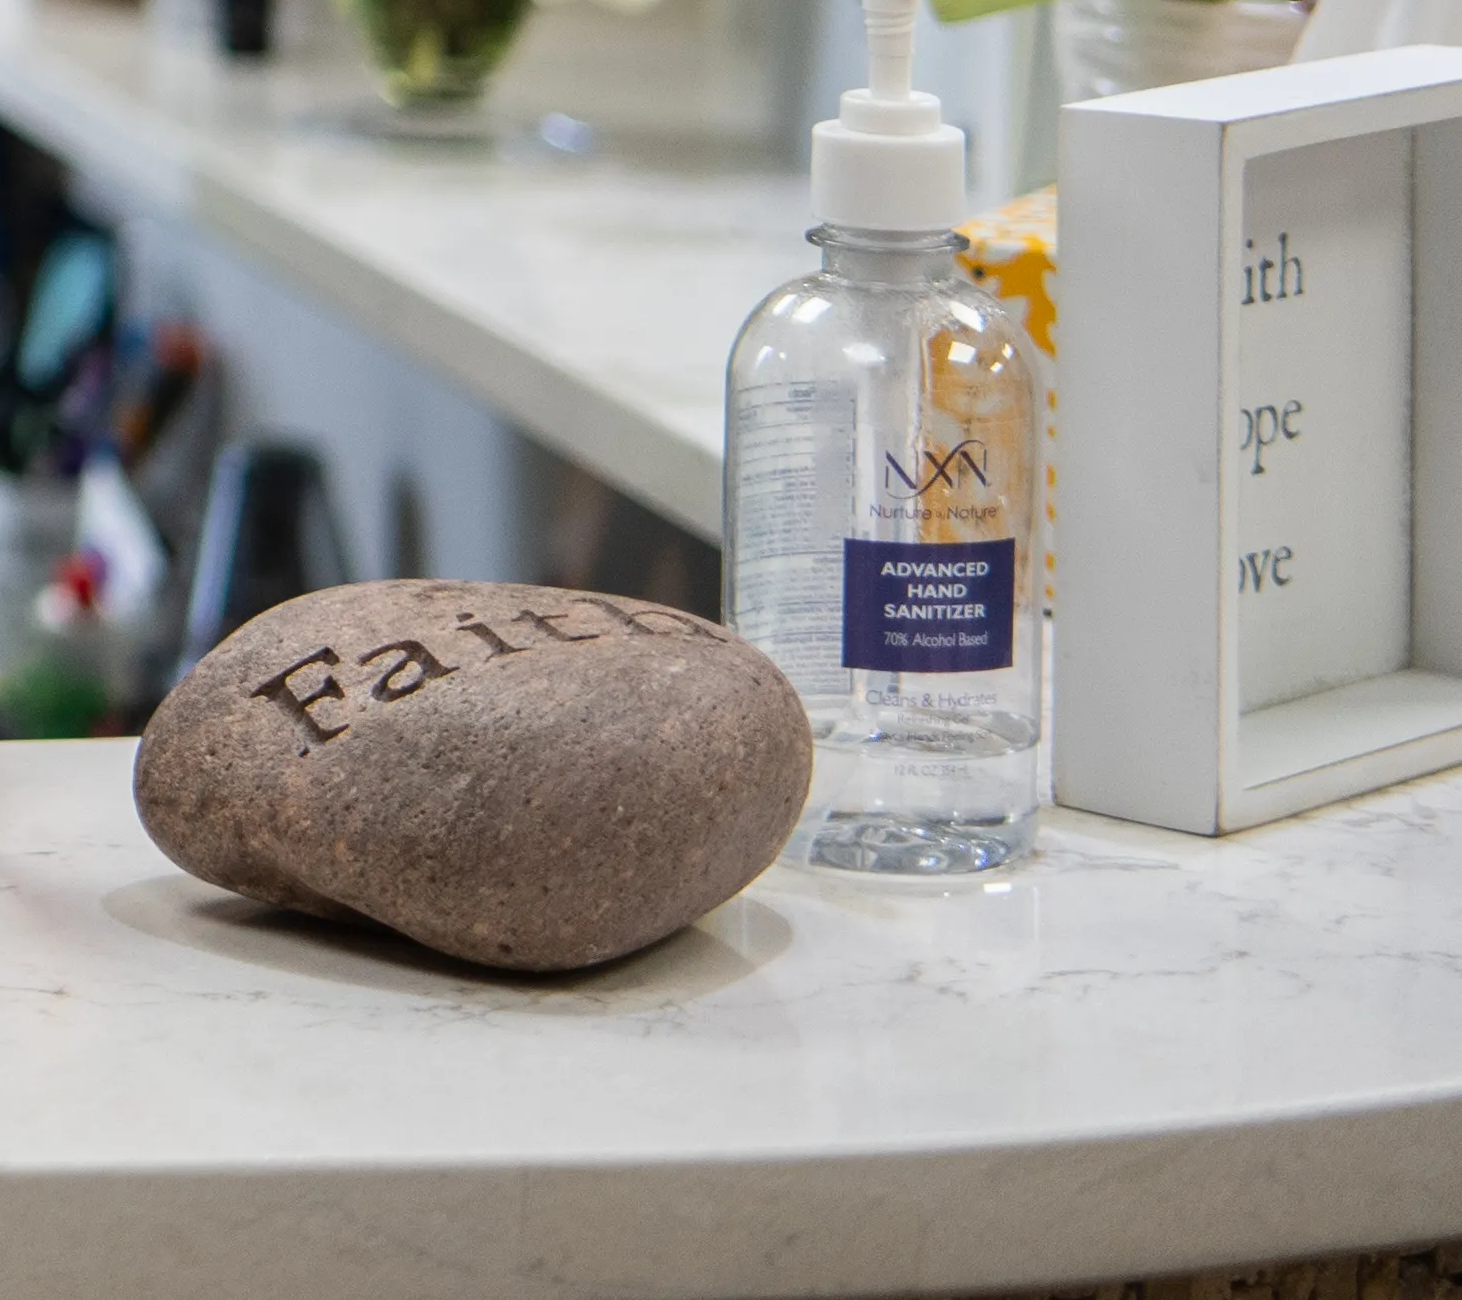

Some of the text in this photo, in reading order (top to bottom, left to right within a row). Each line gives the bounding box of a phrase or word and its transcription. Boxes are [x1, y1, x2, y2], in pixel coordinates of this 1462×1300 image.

[869, 504, 932, 520] Nurture
[947, 504, 998, 520] Nature
[881, 561, 990, 578] ADVANCED
[907, 583, 968, 599] HAND
[883, 603, 987, 620] SANITIZER
[884, 630, 989, 648] 70% Alcohol Based
[251, 599, 729, 758] Faith
[865, 689, 998, 710] Cleans & Hydrates
